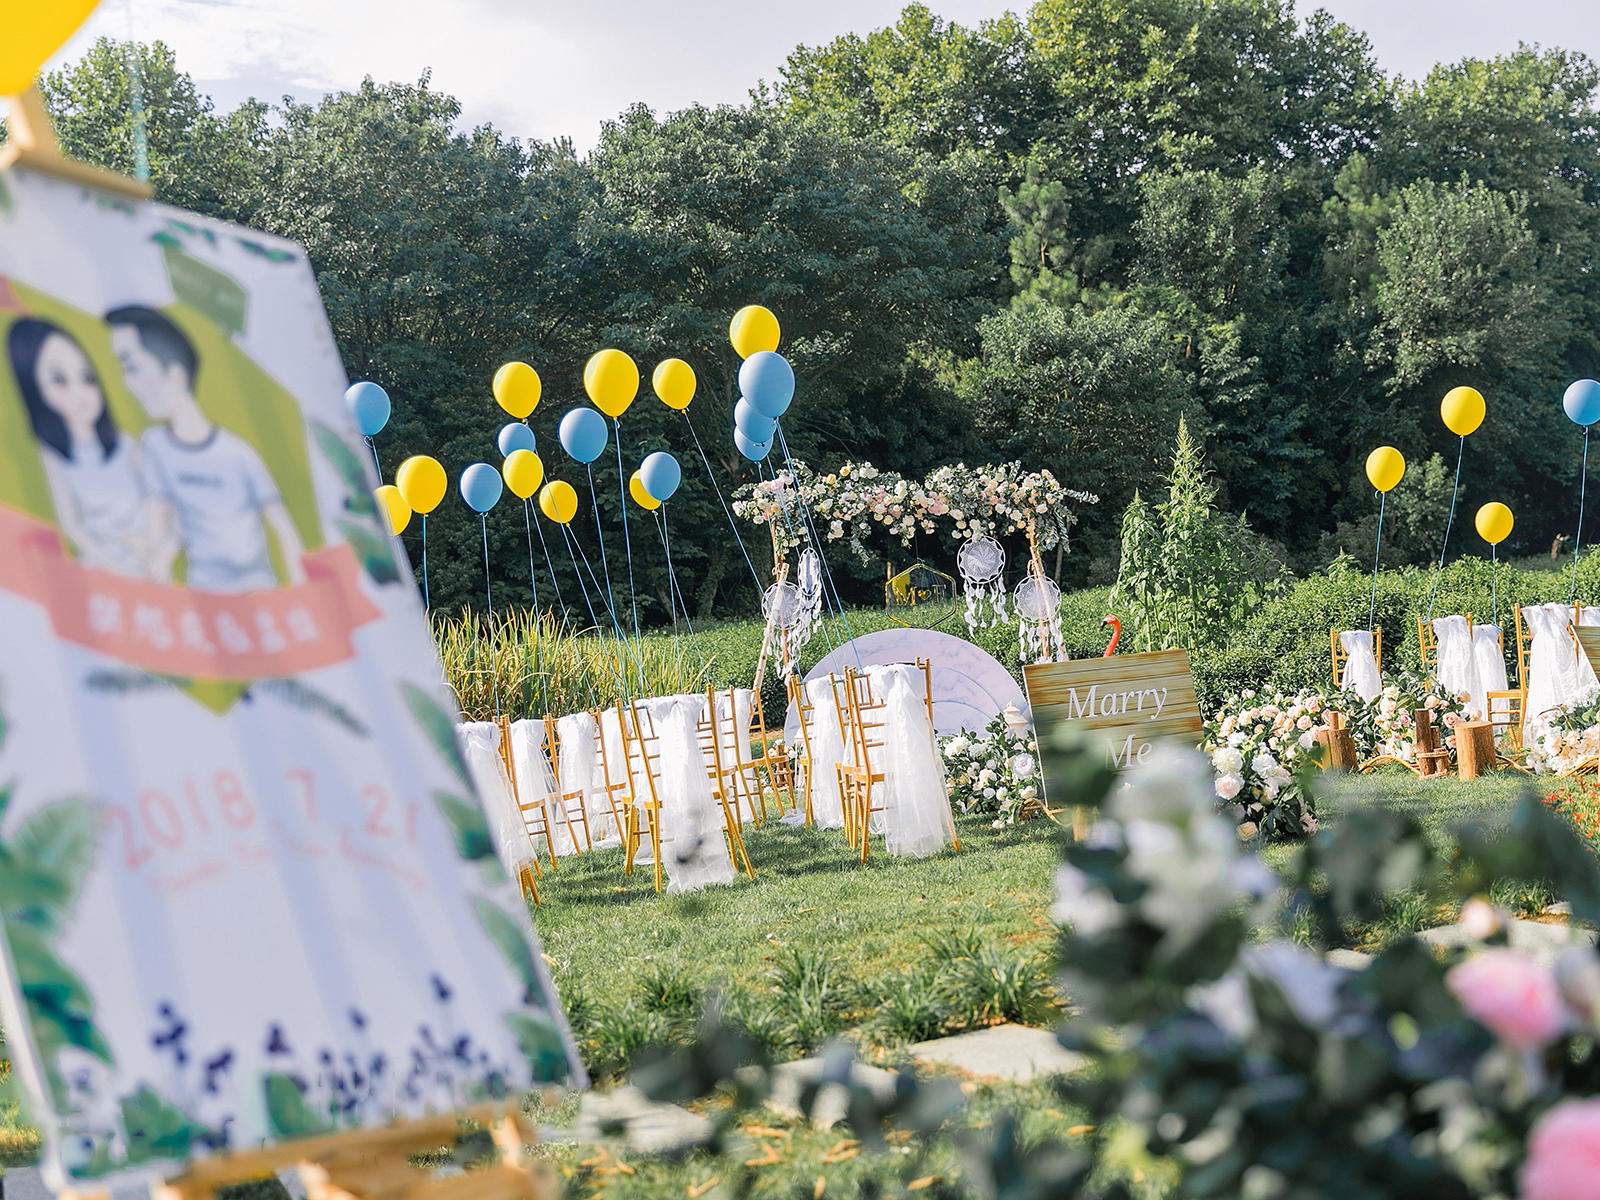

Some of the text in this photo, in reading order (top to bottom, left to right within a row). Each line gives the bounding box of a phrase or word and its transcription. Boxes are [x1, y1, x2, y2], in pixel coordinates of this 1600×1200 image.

[1065, 684, 1168, 721] Marry
[1105, 733, 1152, 769] Me
[105, 767, 256, 870] 2018
